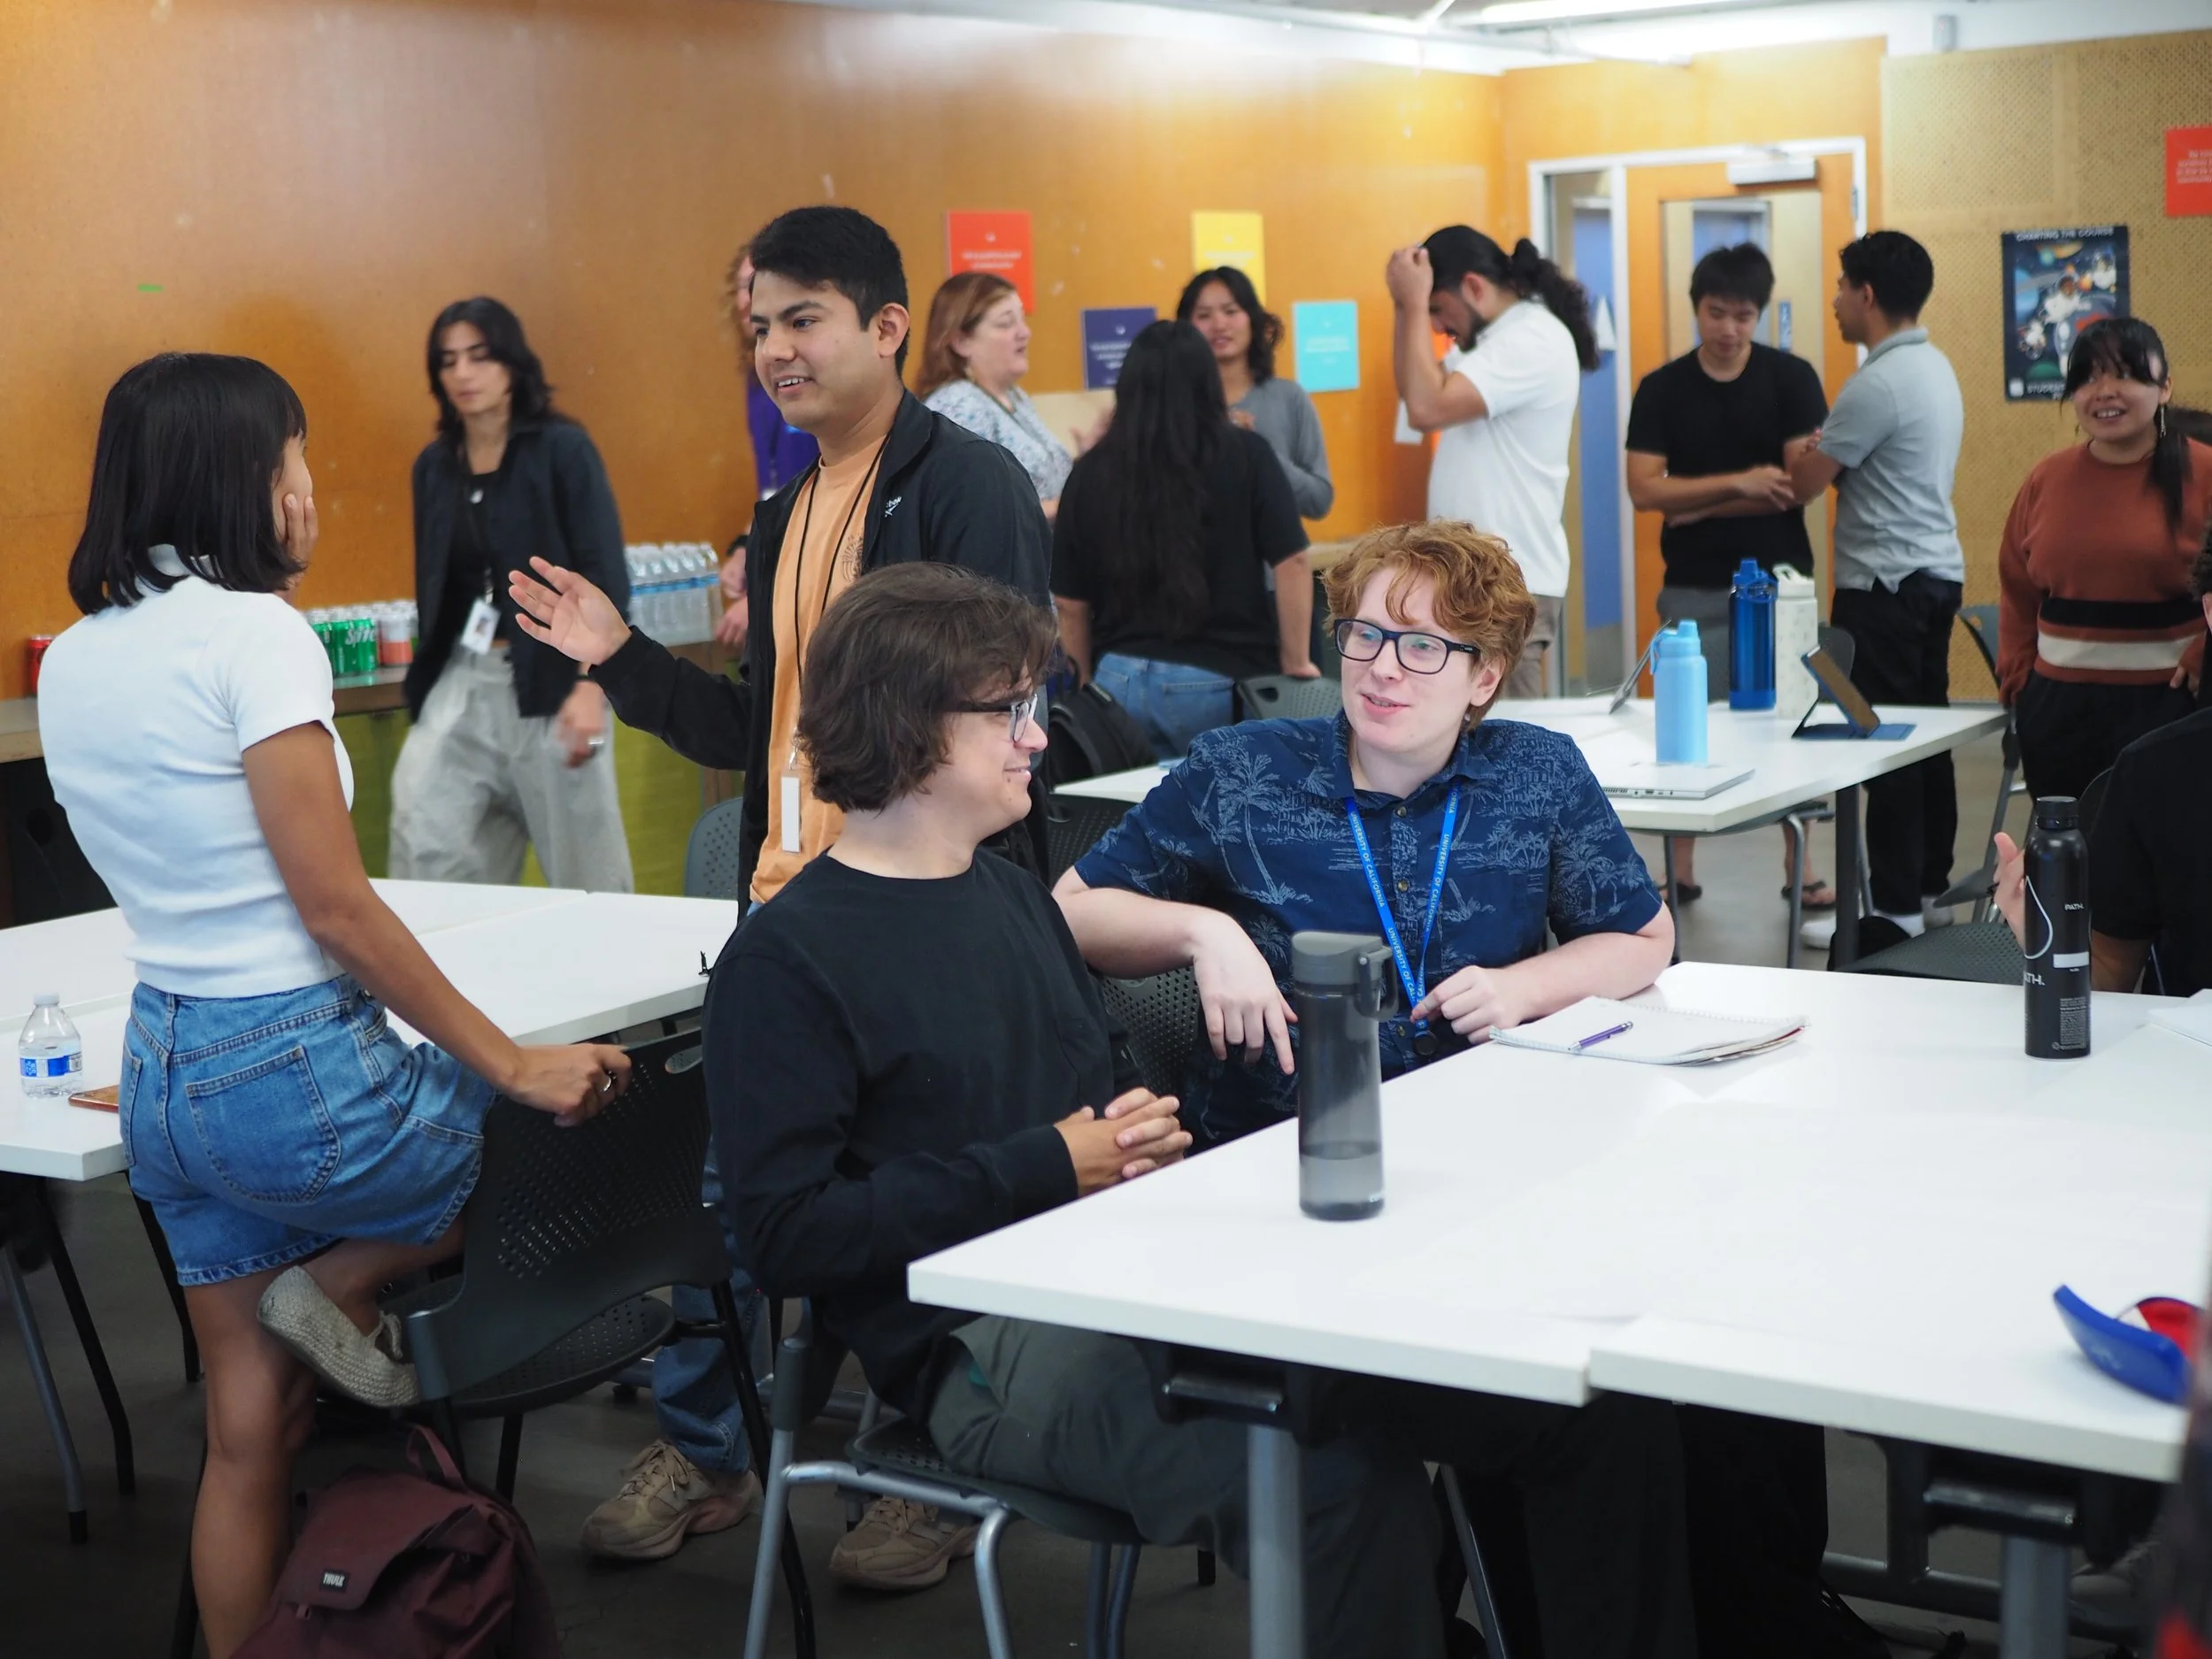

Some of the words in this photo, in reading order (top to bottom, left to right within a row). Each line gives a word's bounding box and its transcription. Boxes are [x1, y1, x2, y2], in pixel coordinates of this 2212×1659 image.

[1350, 810, 1367, 851] UNIVERSITY
[1363, 851, 1371, 863] OF
[1436, 833, 1450, 876] UNIVERSITY
[1366, 864, 1386, 908] CALIFORNIA
[1433, 877, 1442, 888] OF
[1387, 926, 1408, 970] UNIVERSITY
[1402, 971, 1411, 981] OF
